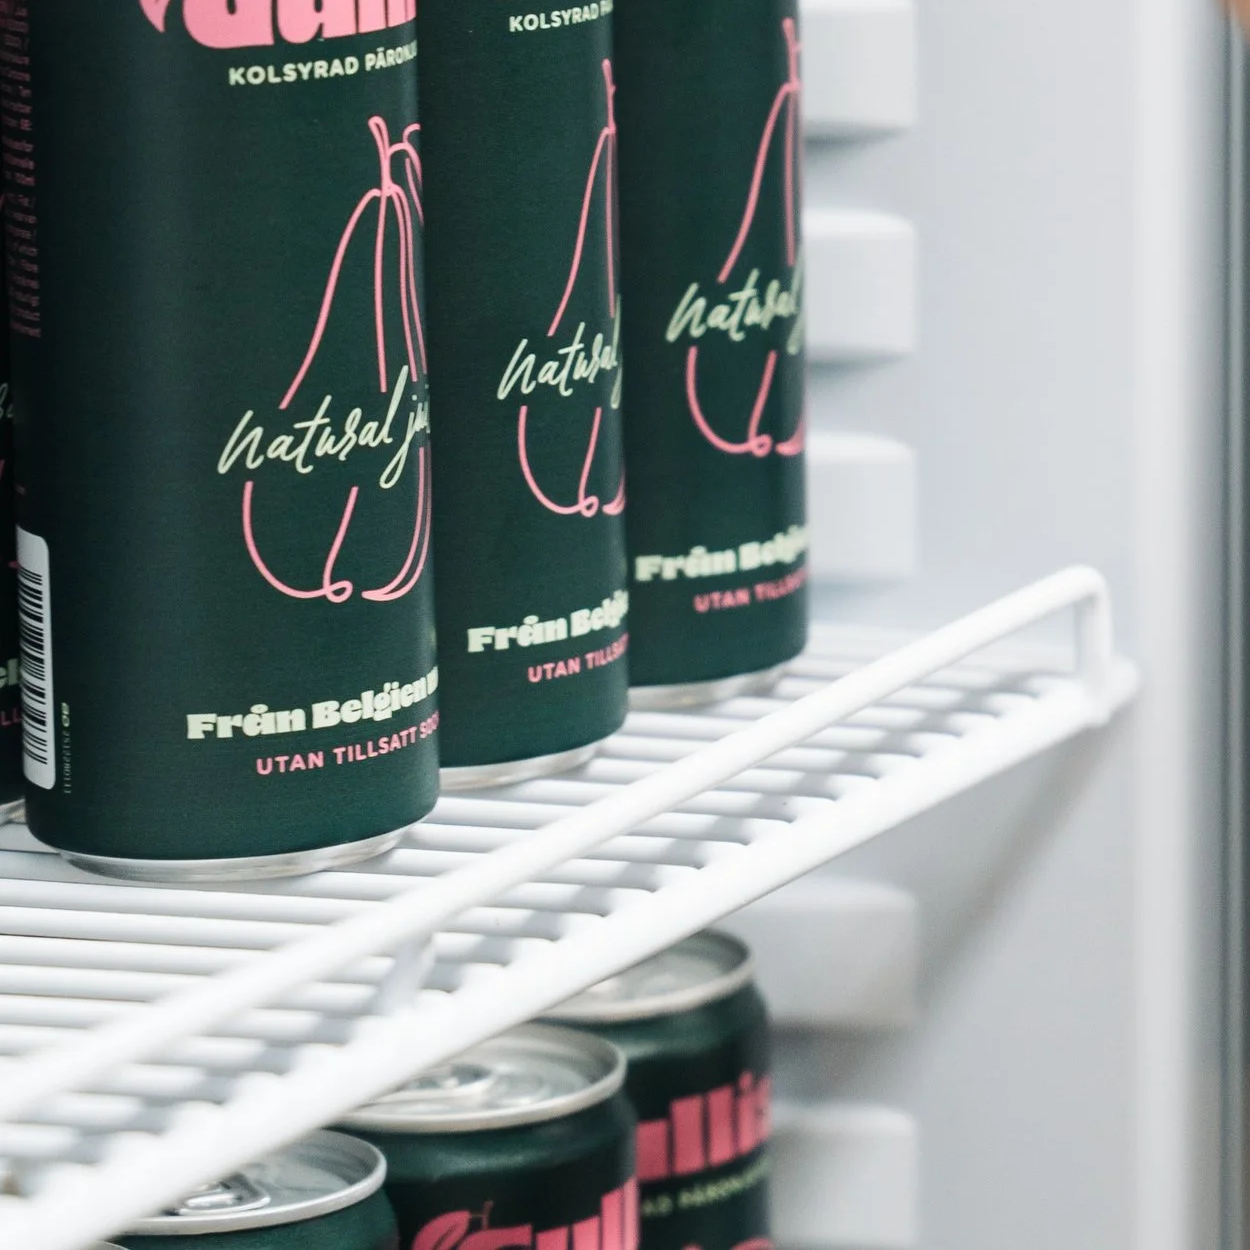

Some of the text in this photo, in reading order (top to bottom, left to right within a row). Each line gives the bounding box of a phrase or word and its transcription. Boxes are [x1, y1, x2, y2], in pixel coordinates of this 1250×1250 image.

[509, 3, 599, 33] KOLSYRAD
[228, 56, 359, 86] KOLSYRAD
[217, 364, 409, 475] natural
[635, 546, 736, 582] Från
[692, 588, 750, 614] UTAN
[467, 615, 568, 653] Från
[527, 657, 581, 683] UTAN
[186, 681, 427, 740] Från Belgien
[256, 751, 325, 776] UTAN
[332, 726, 418, 766] TILLSATT
